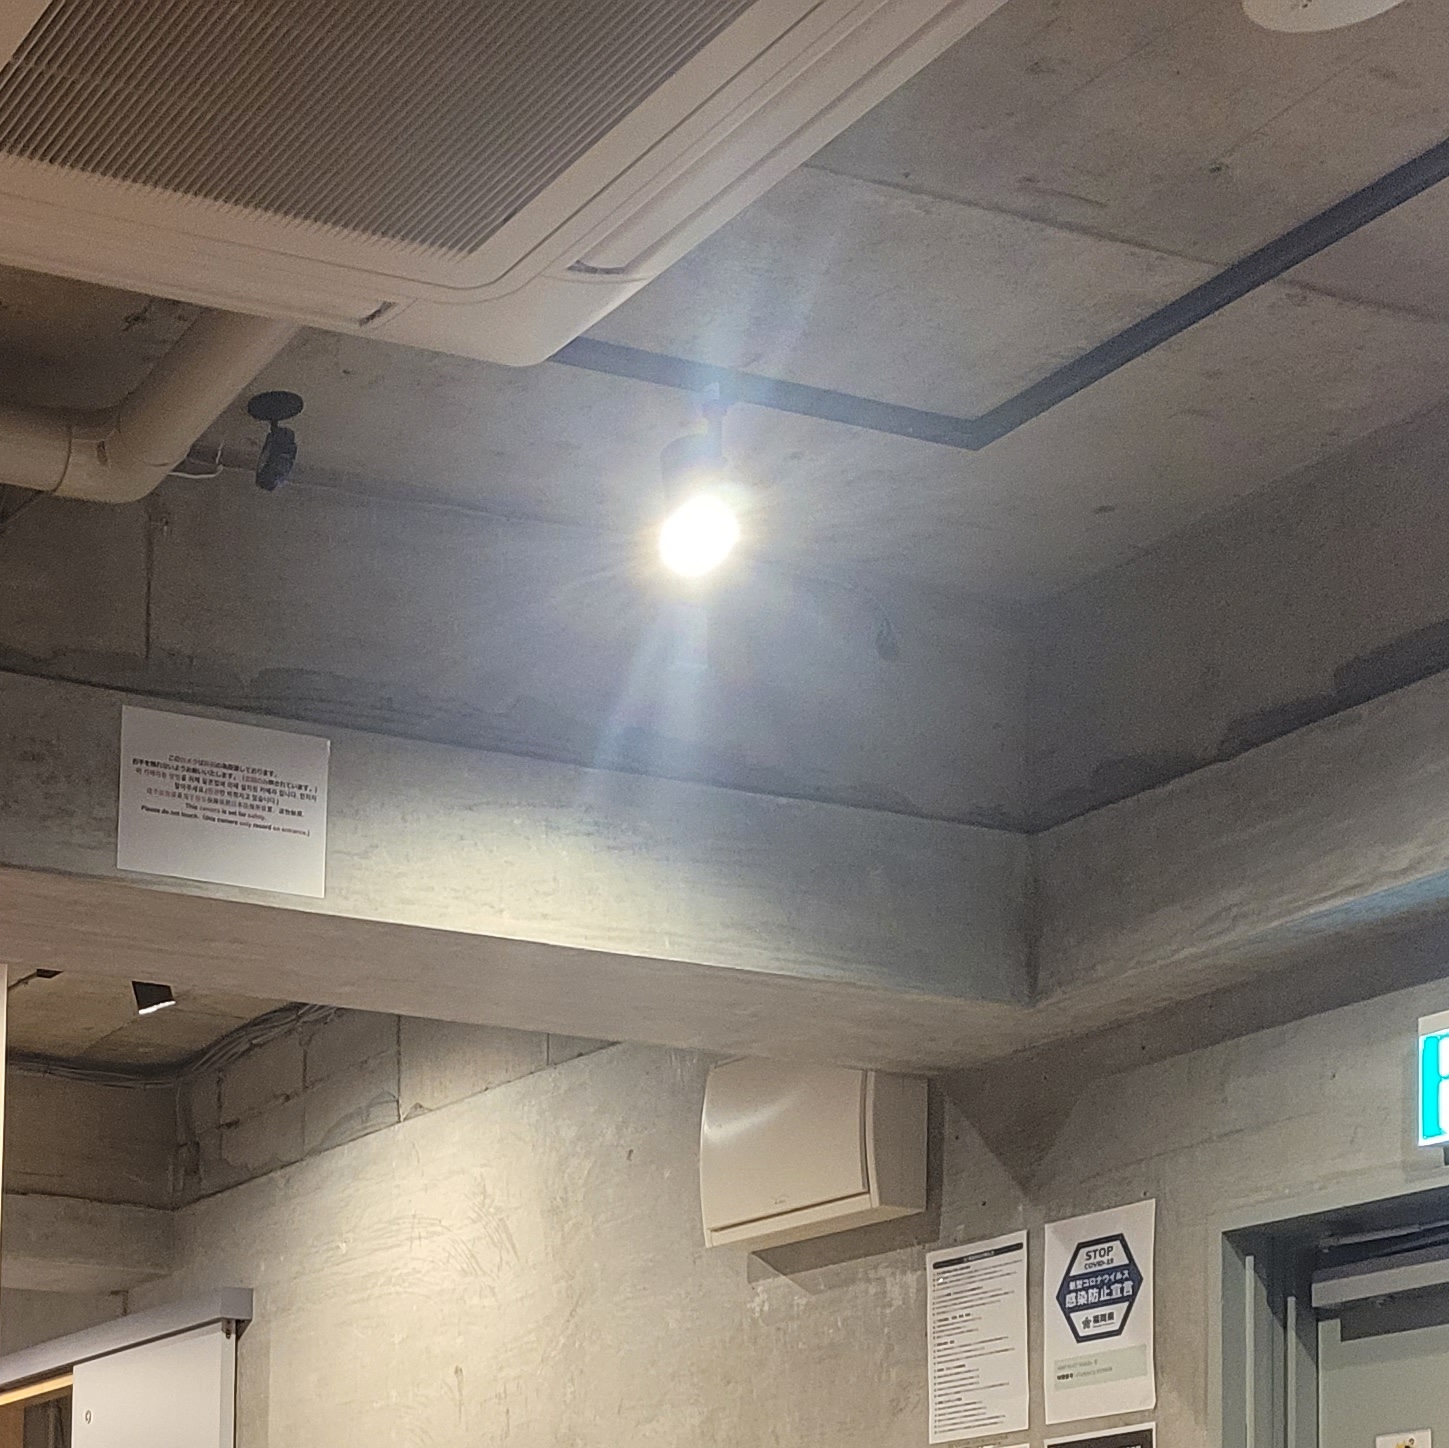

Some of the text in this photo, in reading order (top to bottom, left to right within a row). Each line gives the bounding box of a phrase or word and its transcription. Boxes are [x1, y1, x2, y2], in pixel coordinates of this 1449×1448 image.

[1085, 1246, 1114, 1261] STOP
[1084, 1258, 1114, 1270] COVID-19
[1069, 1269, 1130, 1290] 新型コロナウイルス
[1065, 1281, 1134, 1308] 感染防止宣言
